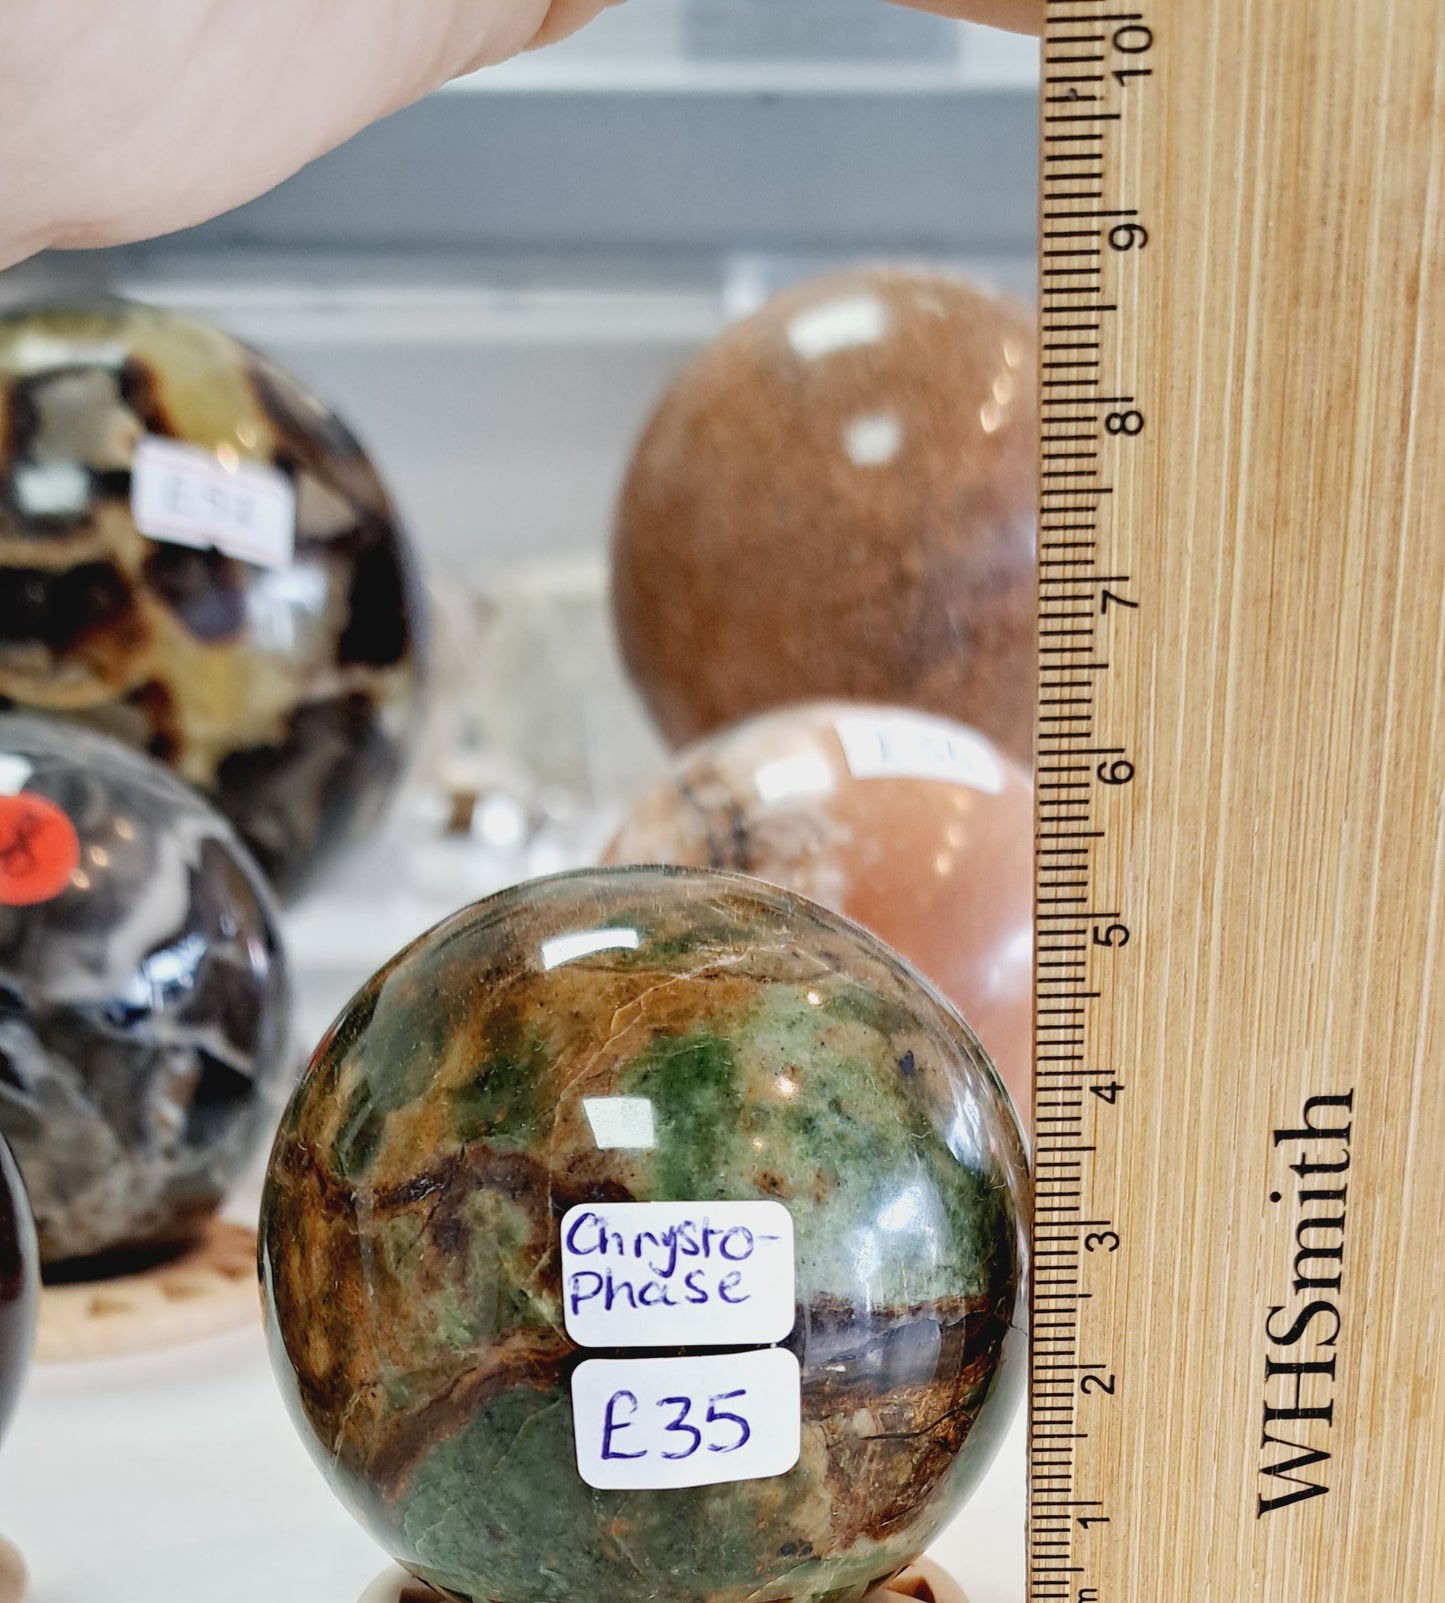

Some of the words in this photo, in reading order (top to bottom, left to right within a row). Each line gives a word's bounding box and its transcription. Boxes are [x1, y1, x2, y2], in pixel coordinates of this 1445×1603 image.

[1112, 24, 1154, 88] 10
[1108, 222, 1148, 252] 9
[1104, 409, 1144, 437] 8
[1101, 589, 1139, 615] 7
[1096, 760, 1135, 786] 6
[1093, 923, 1130, 948] 5
[1089, 1081, 1125, 1105] 4
[1084, 1230, 1120, 1253] 3
[1256, 1087, 1354, 1520] WHSmith
[1080, 1374, 1116, 1395] 2
[601, 1389, 751, 1460] £35
[1075, 1516, 1111, 1530] 1
